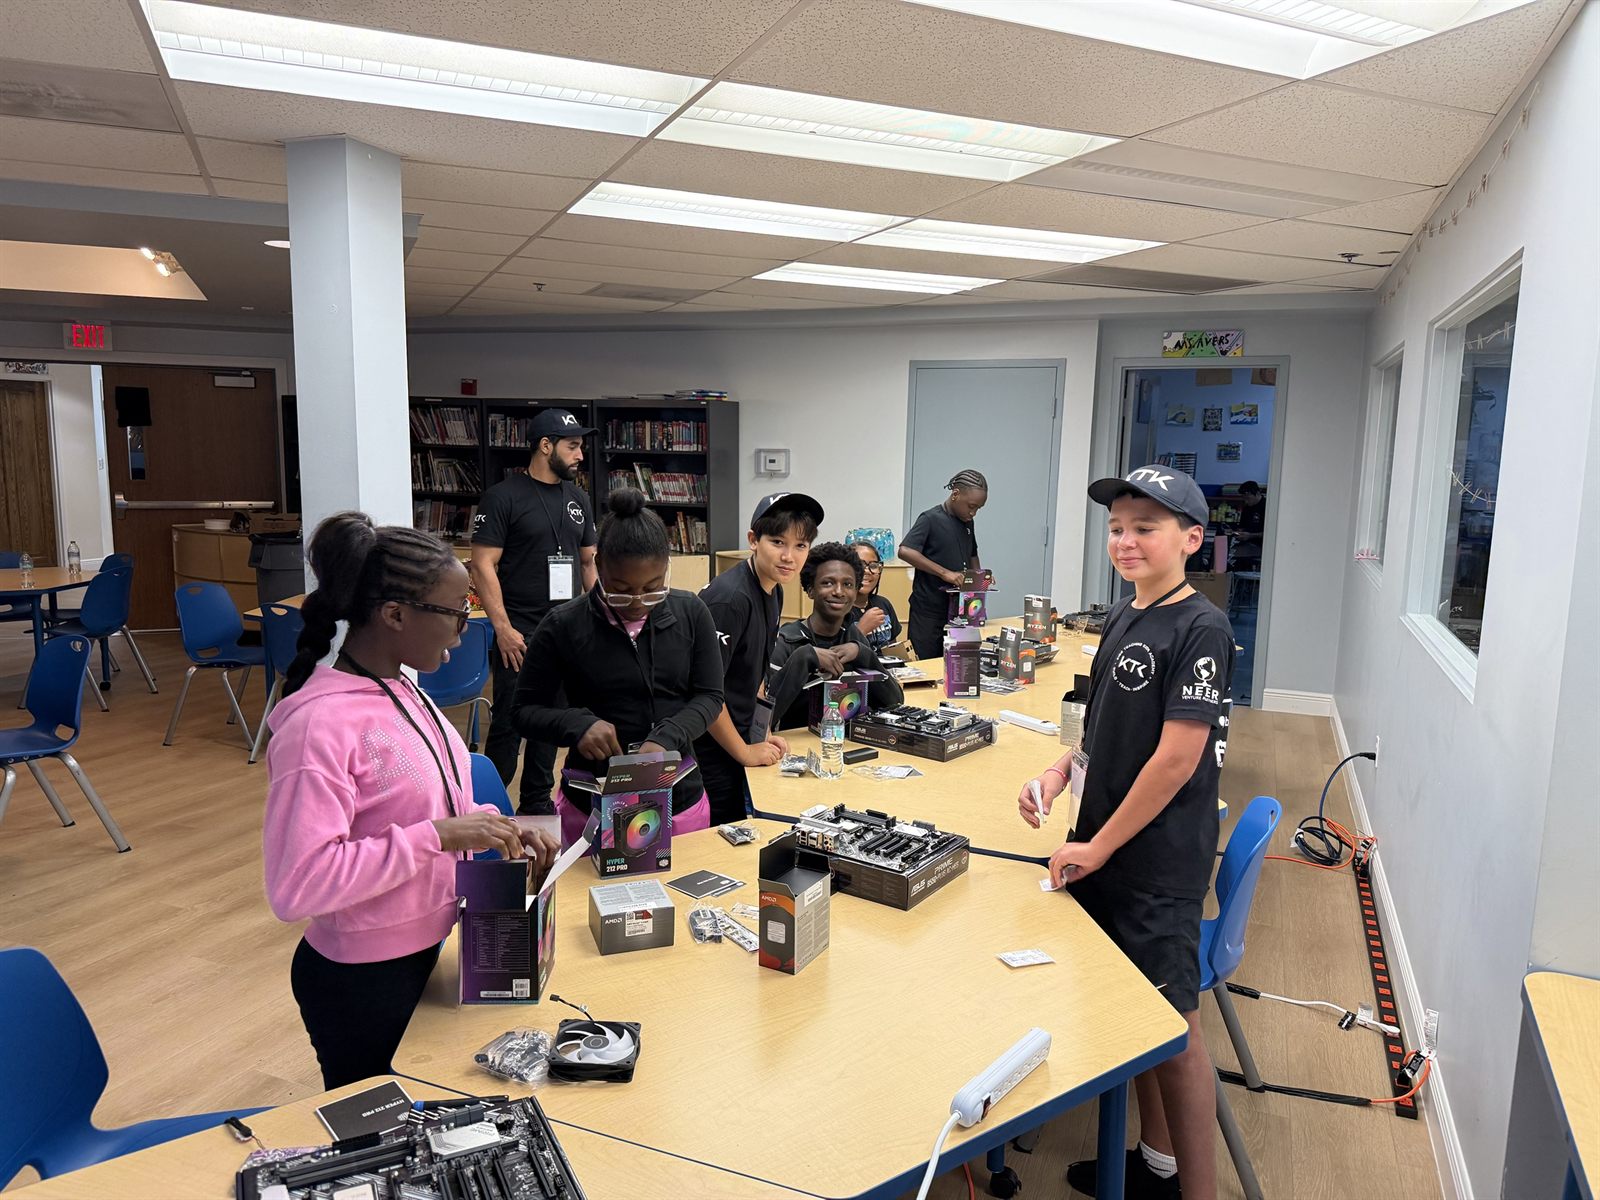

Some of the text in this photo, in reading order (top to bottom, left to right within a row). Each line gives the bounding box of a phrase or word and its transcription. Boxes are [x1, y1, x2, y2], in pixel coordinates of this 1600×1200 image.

[72, 324, 105, 348] EXIT
[1118, 655, 1148, 679] KTK
[1182, 685, 1220, 701] NEER
[606, 857, 625, 866] HYPER
[606, 864, 628, 873] 212 PRO
